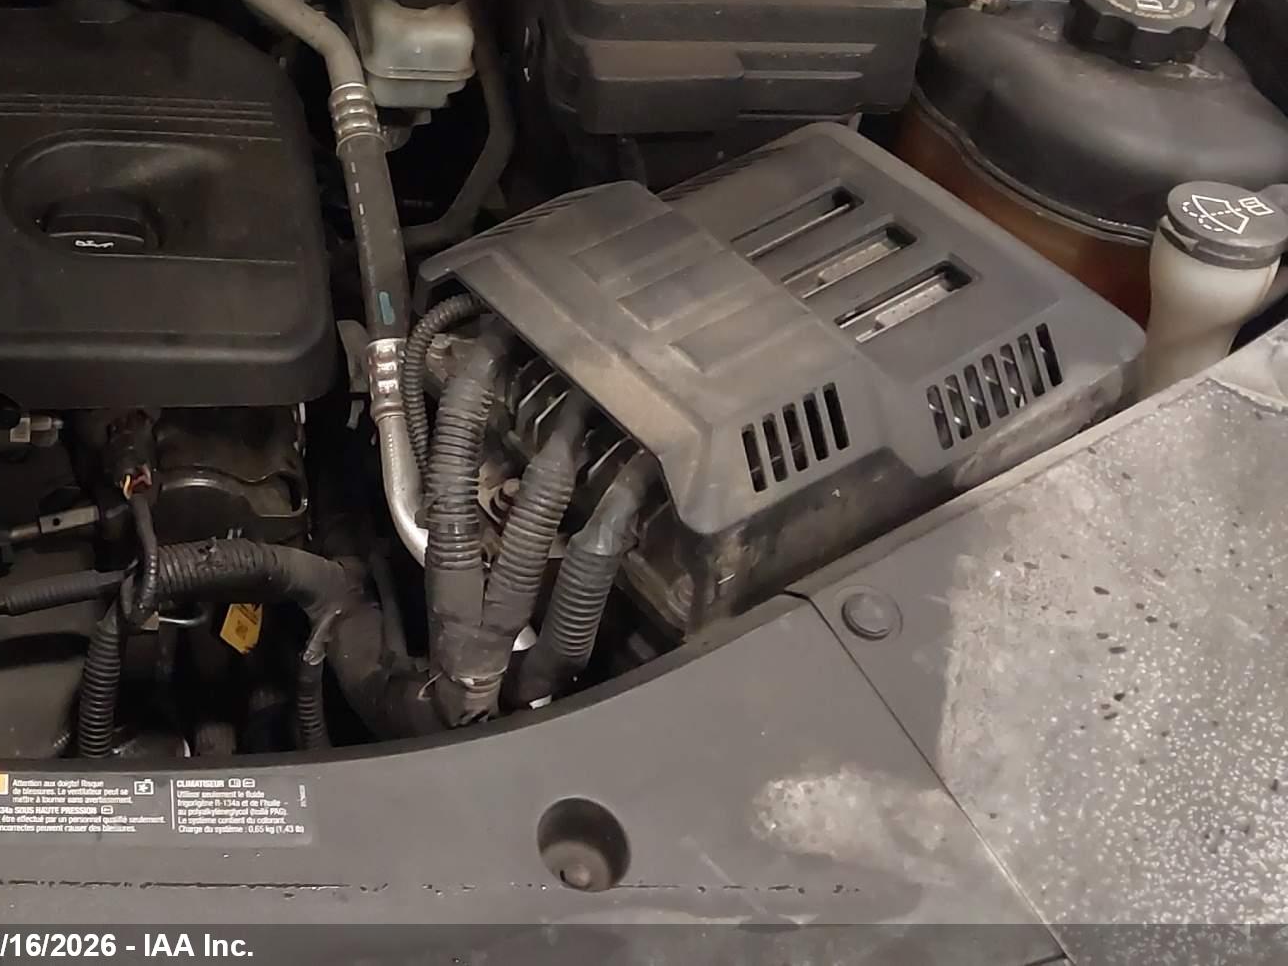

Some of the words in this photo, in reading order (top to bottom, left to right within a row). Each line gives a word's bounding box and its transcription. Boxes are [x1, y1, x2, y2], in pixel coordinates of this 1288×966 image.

[176, 780, 225, 788] CLIMATISEUR
[104, 788, 118, 796] peut
[60, 806, 98, 814] PRESSION
[68, 816, 102, 824] personnel
[102, 816, 128, 824] qualifié
